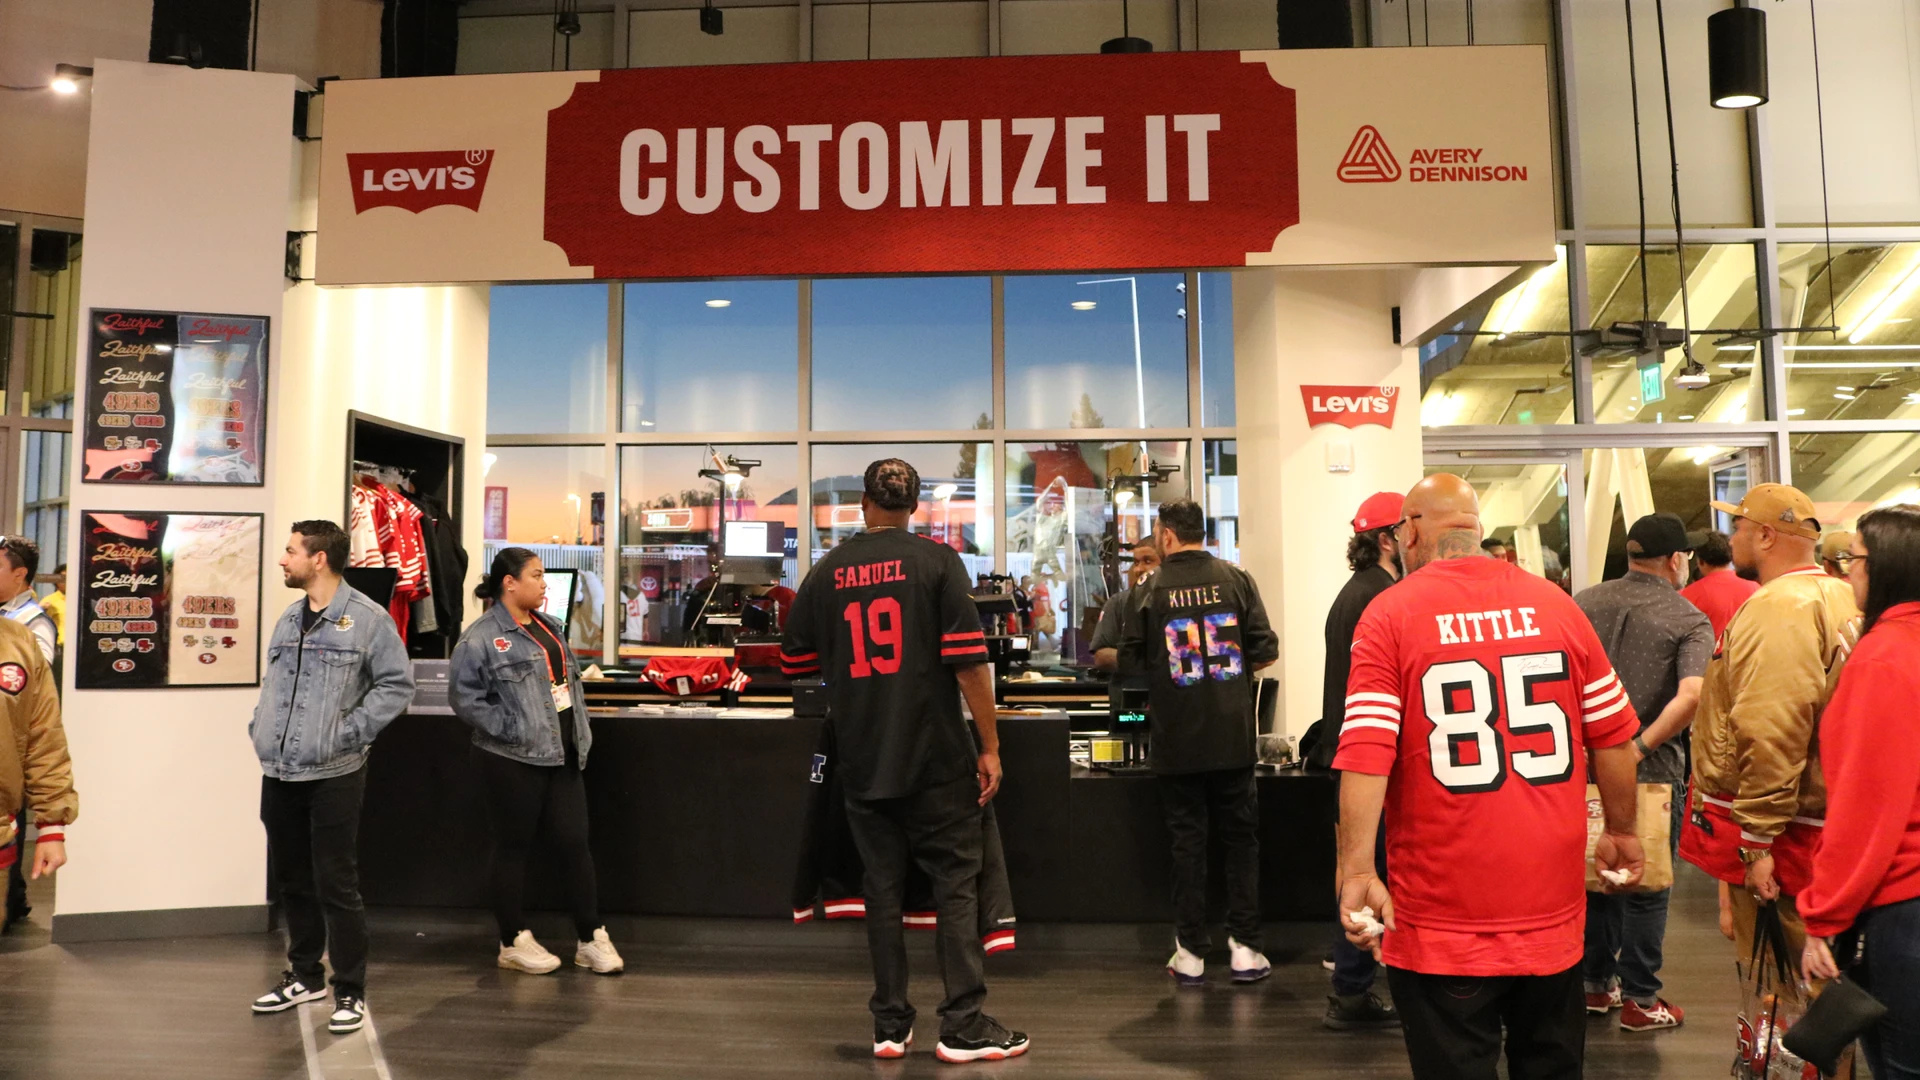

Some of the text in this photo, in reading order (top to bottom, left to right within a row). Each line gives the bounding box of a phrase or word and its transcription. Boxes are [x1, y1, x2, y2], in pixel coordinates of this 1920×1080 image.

[619, 113, 1221, 216] CUSTOMIZE IT
[1409, 148, 1484, 164] AVERY
[1409, 166, 1529, 184] DENNISON
[102, 391, 161, 413] 49ERS
[97, 414, 131, 427] 49ERS
[834, 560, 907, 590] SAMUEL
[95, 597, 153, 618] 49ERS
[182, 595, 236, 616] 49ERS
[1169, 585, 1222, 608] KITTLE
[89, 620, 123, 634] 49ERS
[843, 596, 903, 678] 19
[1436, 607, 1541, 645] KITTLE
[1164, 613, 1243, 687] 85
[1420, 651, 1575, 794] 85
